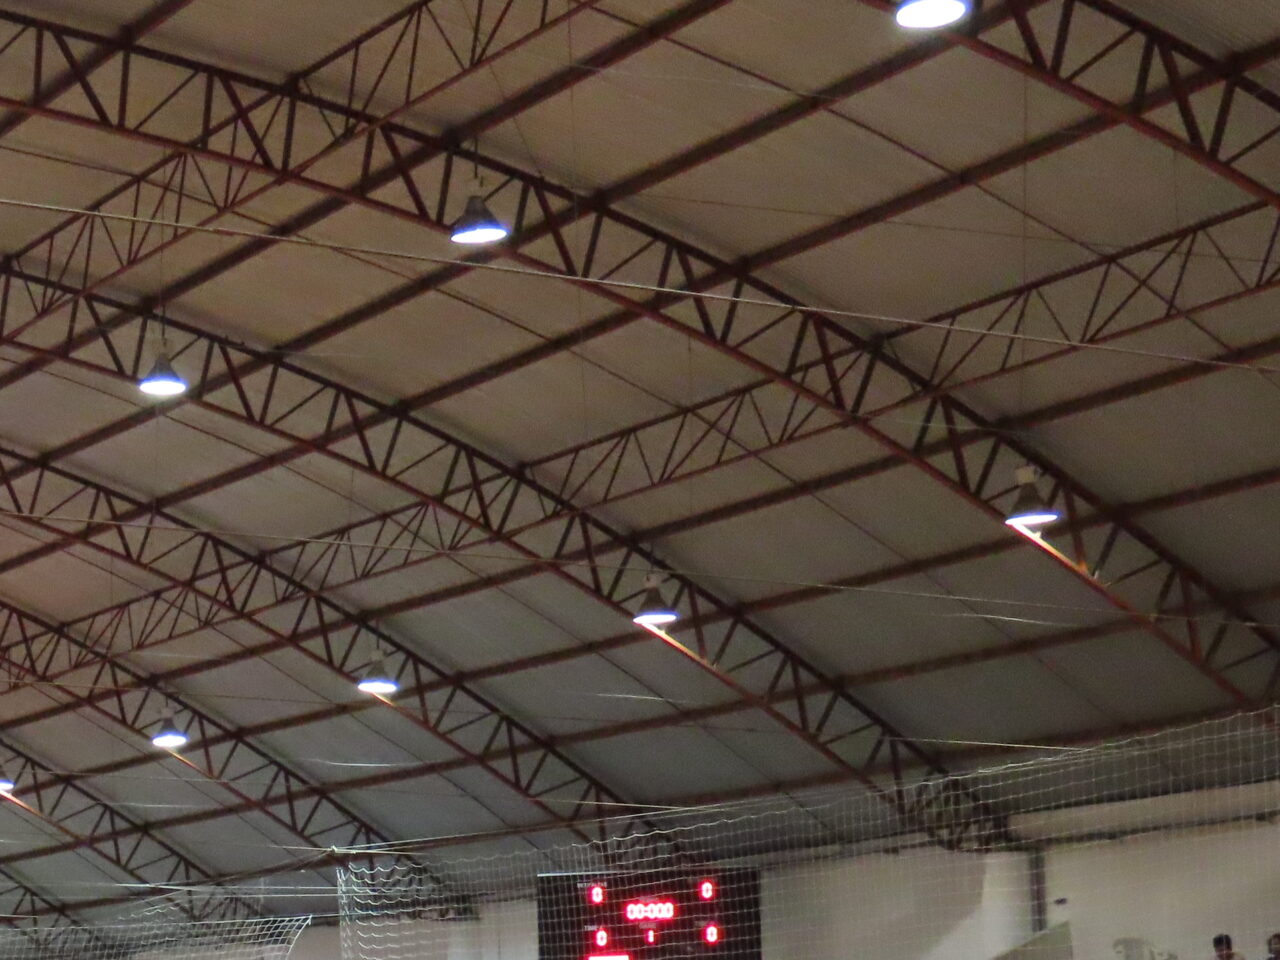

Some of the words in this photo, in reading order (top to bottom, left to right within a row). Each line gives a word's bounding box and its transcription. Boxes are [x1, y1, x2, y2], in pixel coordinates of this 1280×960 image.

[591, 886, 603, 903] 0
[700, 881, 713, 898] 0
[595, 929, 608, 946] 0
[647, 929, 654, 943] 1
[705, 925, 718, 942] 0
